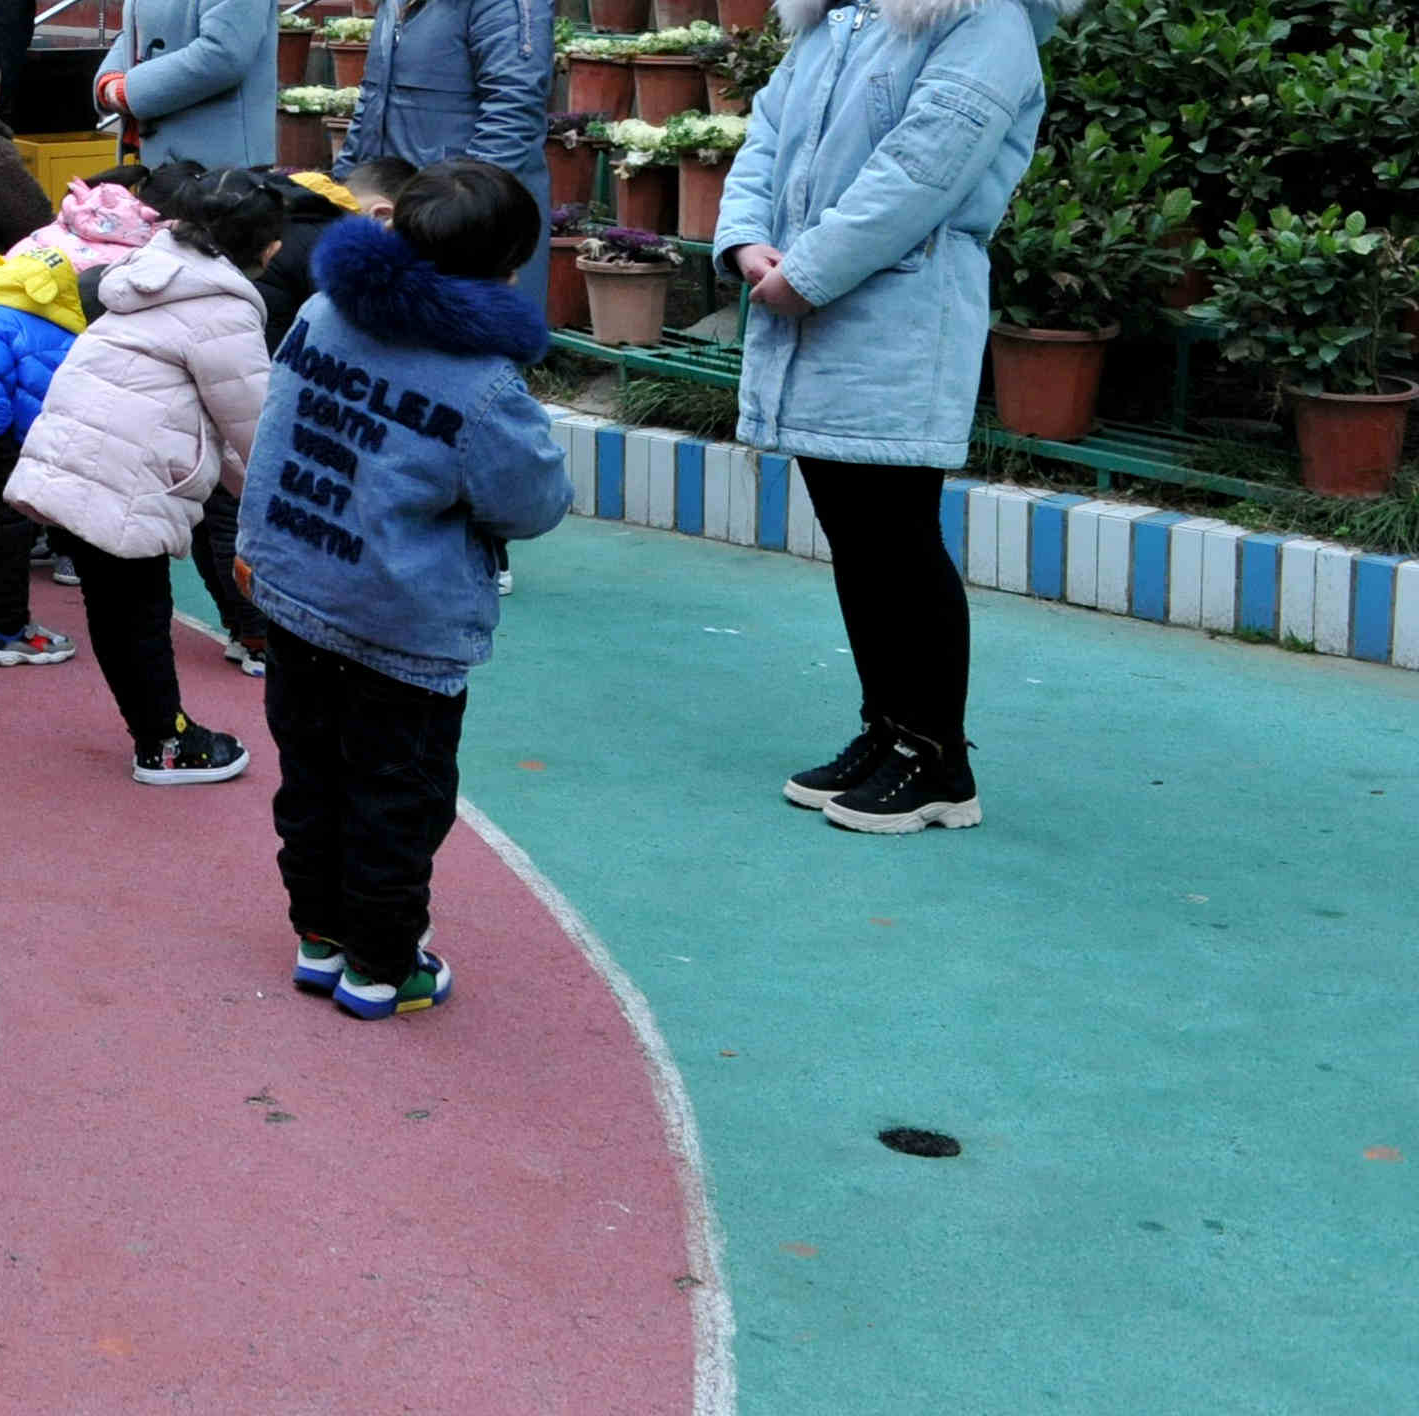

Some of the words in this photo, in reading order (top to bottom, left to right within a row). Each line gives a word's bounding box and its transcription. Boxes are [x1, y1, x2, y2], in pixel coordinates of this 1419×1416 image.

[297, 387, 388, 454] SOUTH
[279, 459, 352, 517] EAST
[265, 494, 365, 566] NORTH
